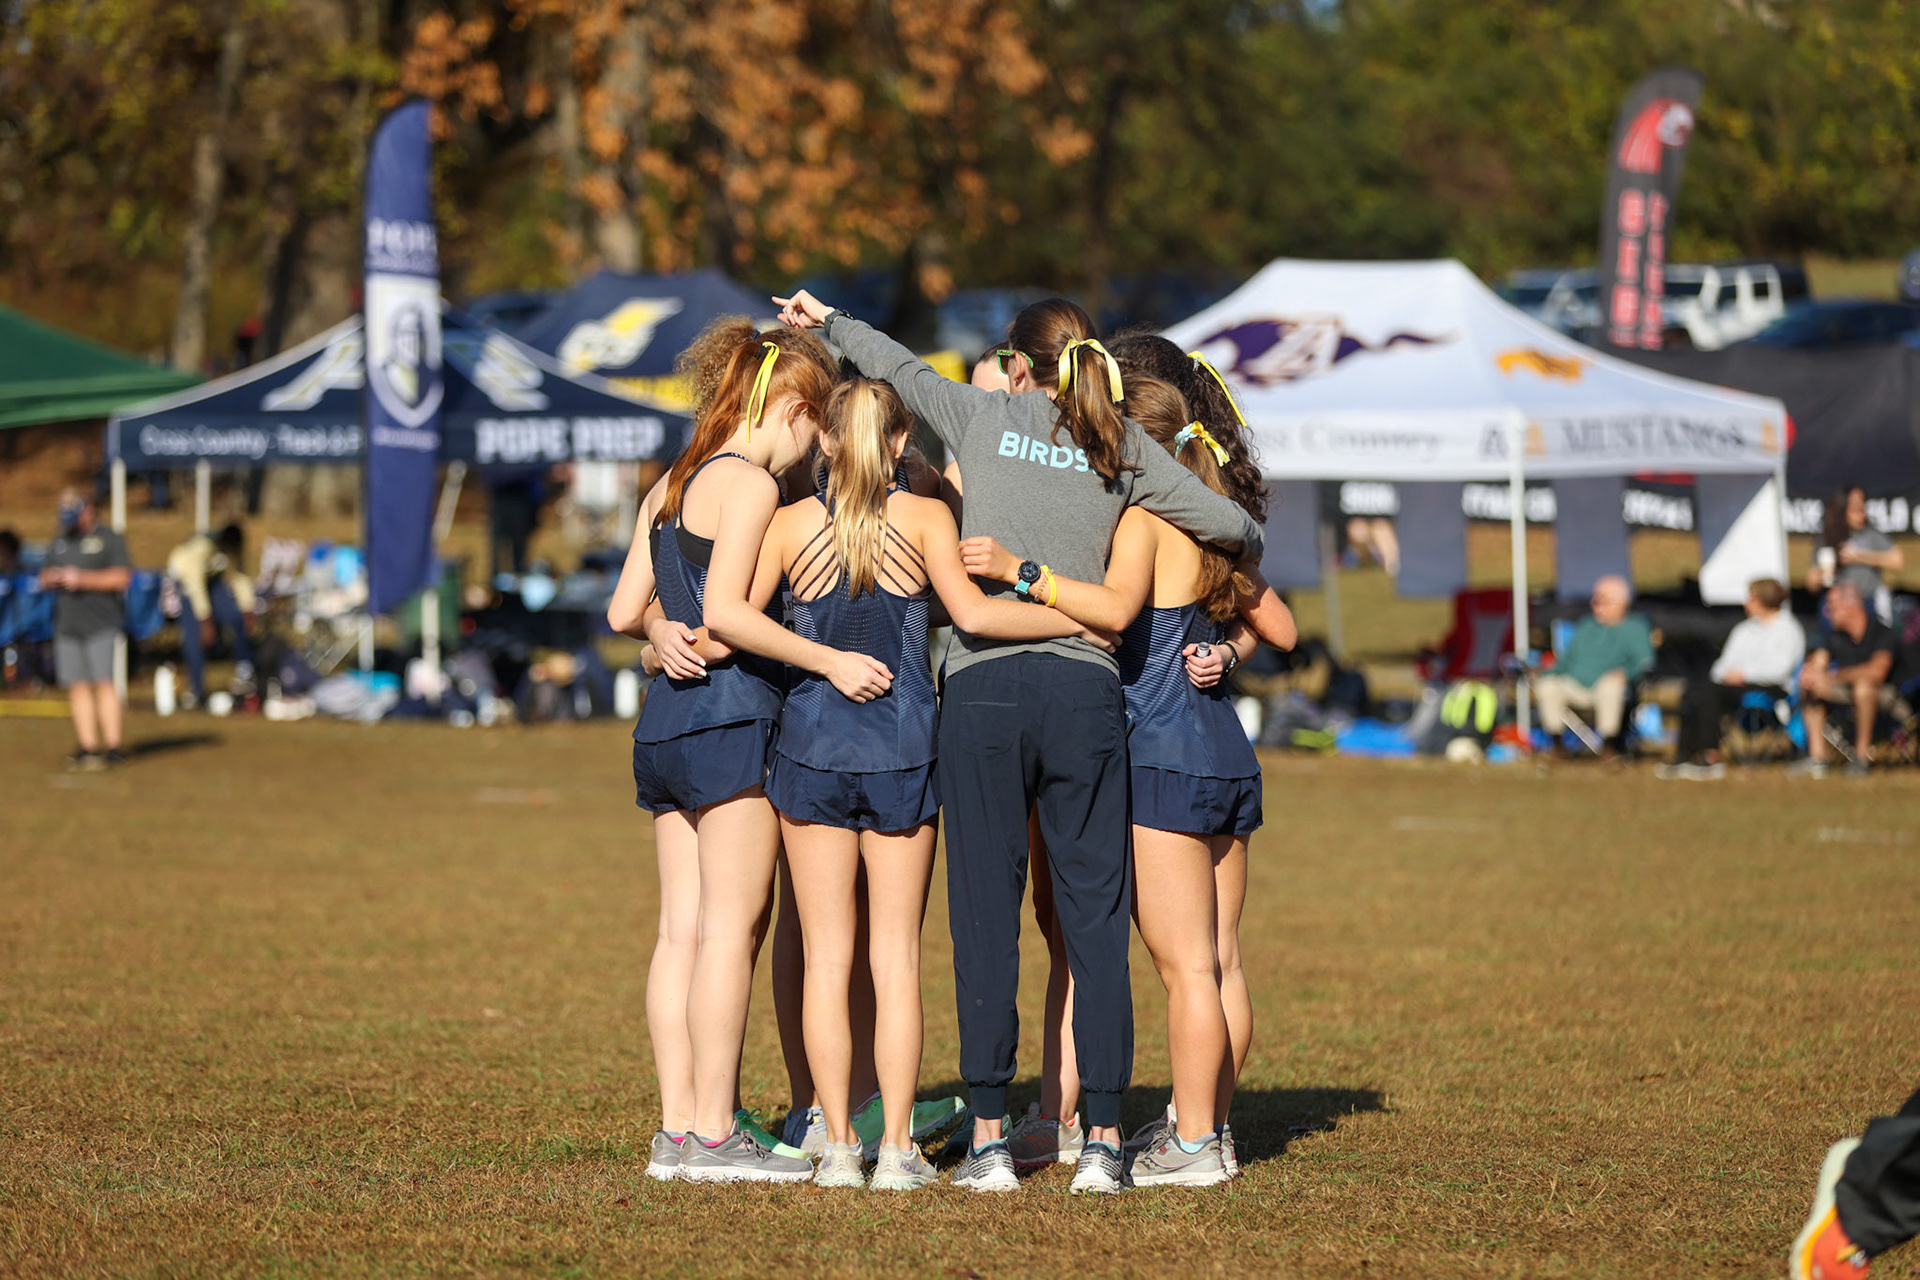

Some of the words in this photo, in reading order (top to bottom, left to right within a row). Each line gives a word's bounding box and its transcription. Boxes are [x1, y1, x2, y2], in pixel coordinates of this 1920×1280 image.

[475, 417, 568, 464] POPE
[572, 416, 665, 460] PREP
[1561, 416, 1746, 459] MUSTANGS
